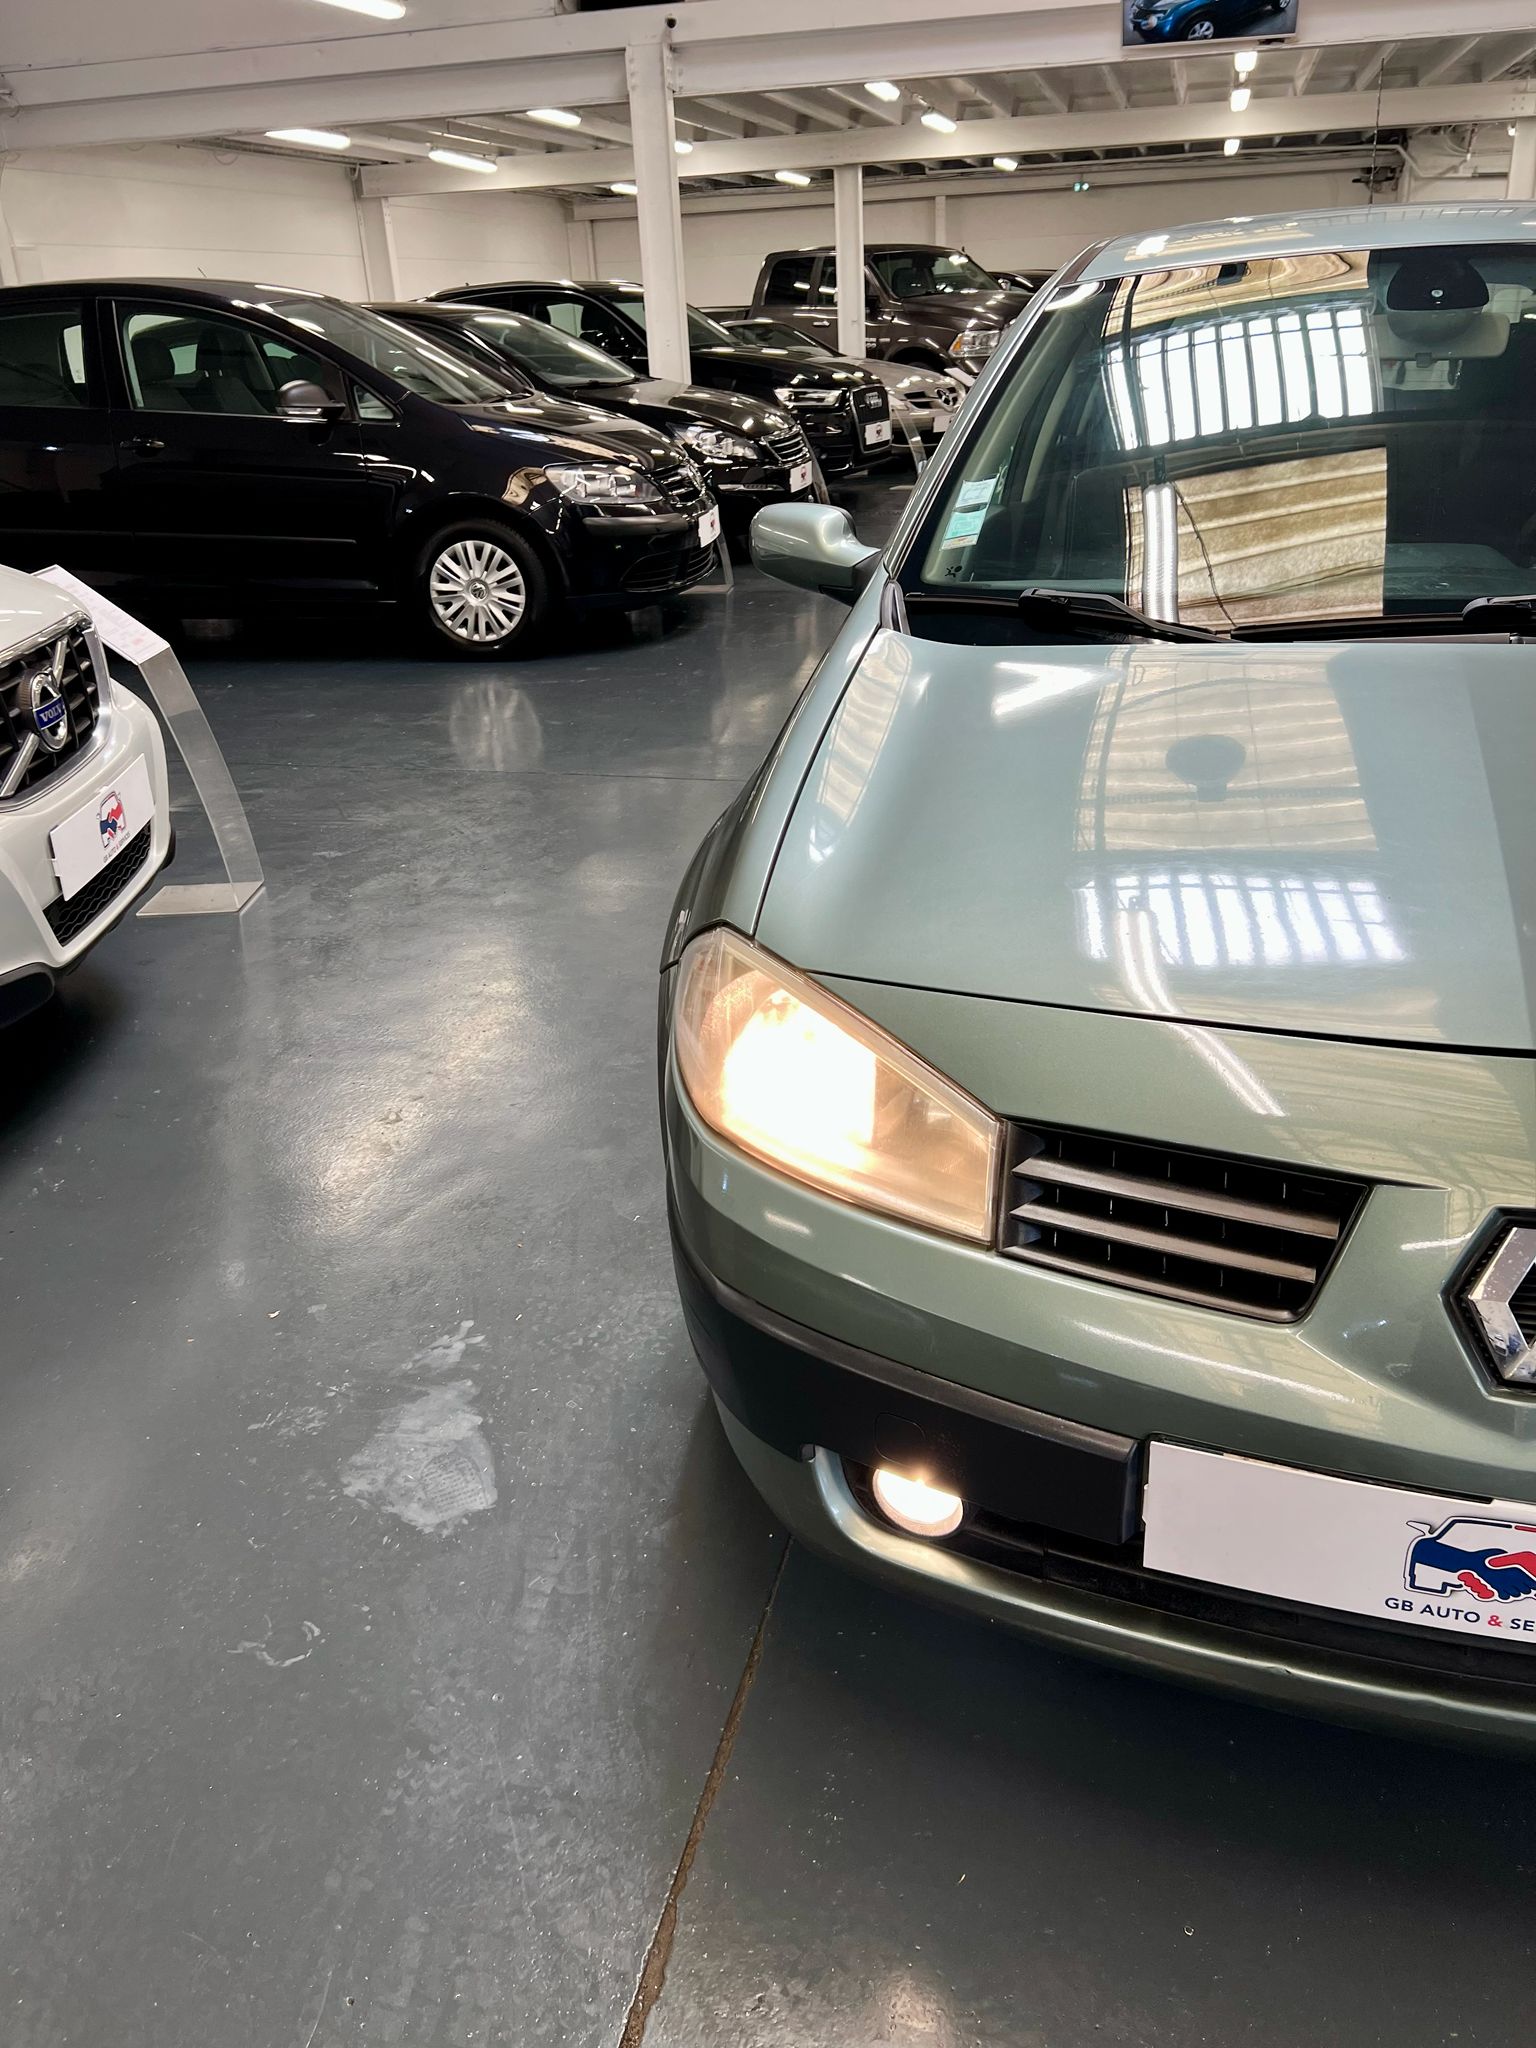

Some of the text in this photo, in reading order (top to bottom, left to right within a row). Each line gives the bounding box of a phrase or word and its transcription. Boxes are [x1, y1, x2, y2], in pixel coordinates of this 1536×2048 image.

[39, 702, 65, 722] VOLV
[1384, 1597, 1536, 1632] GB AUTO & SE
